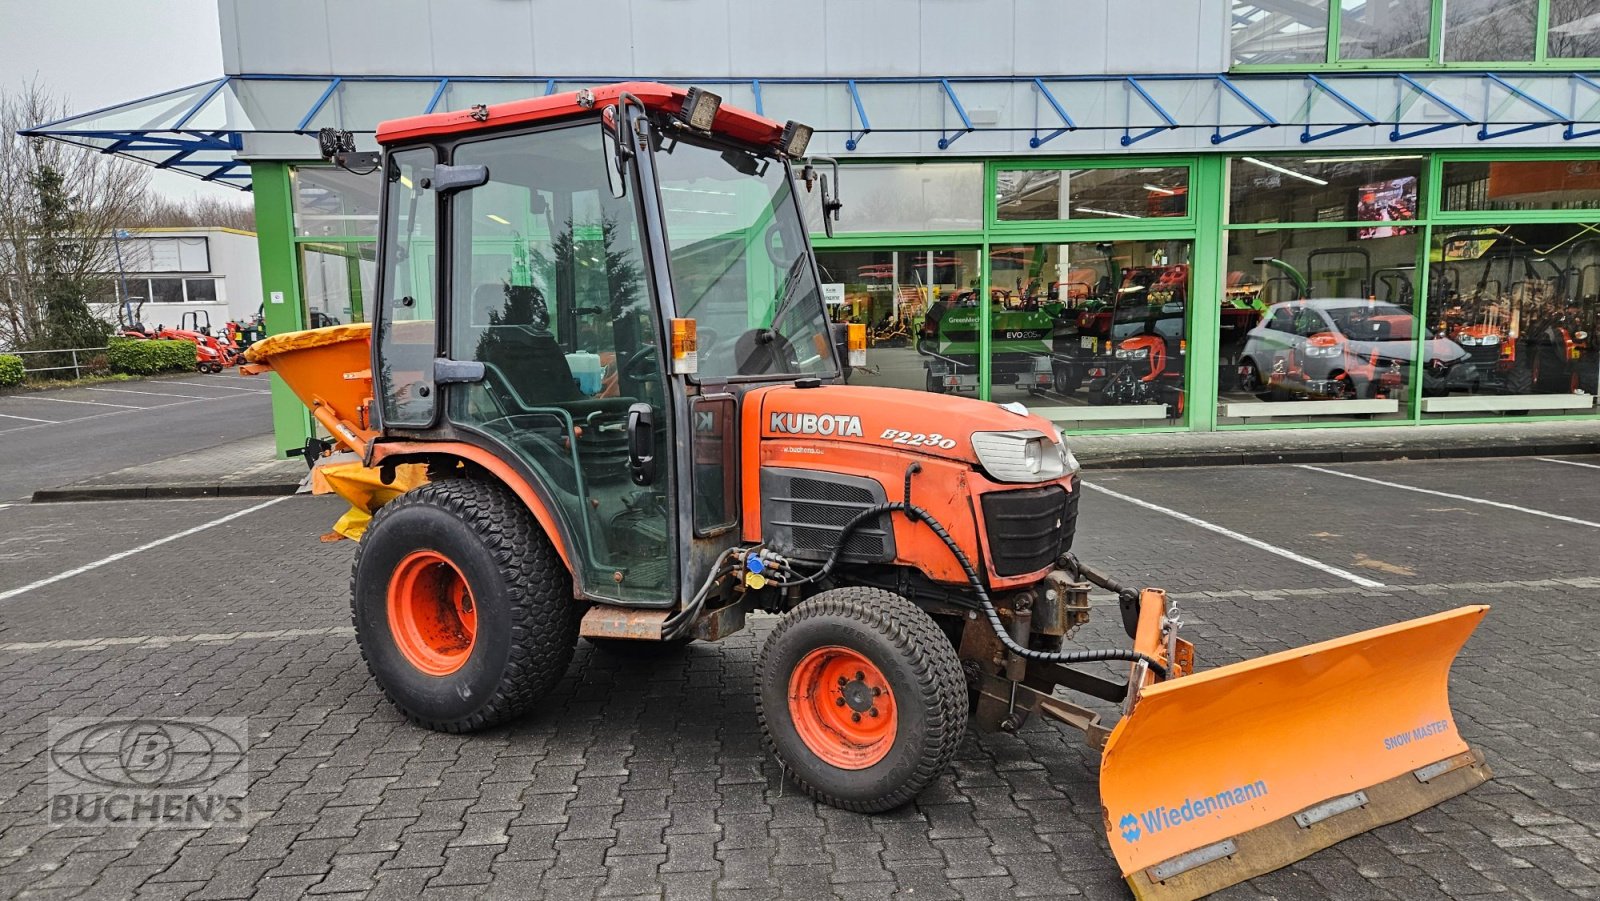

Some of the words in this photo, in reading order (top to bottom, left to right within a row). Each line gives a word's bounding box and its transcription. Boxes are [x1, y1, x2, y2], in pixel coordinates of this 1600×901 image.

[770, 411, 864, 437] KUBOTA
[880, 428, 957, 450] B2230
[1384, 731, 1411, 750] SNOW
[1412, 719, 1449, 741] MASTER
[1140, 780, 1268, 834] Wiedenmann
